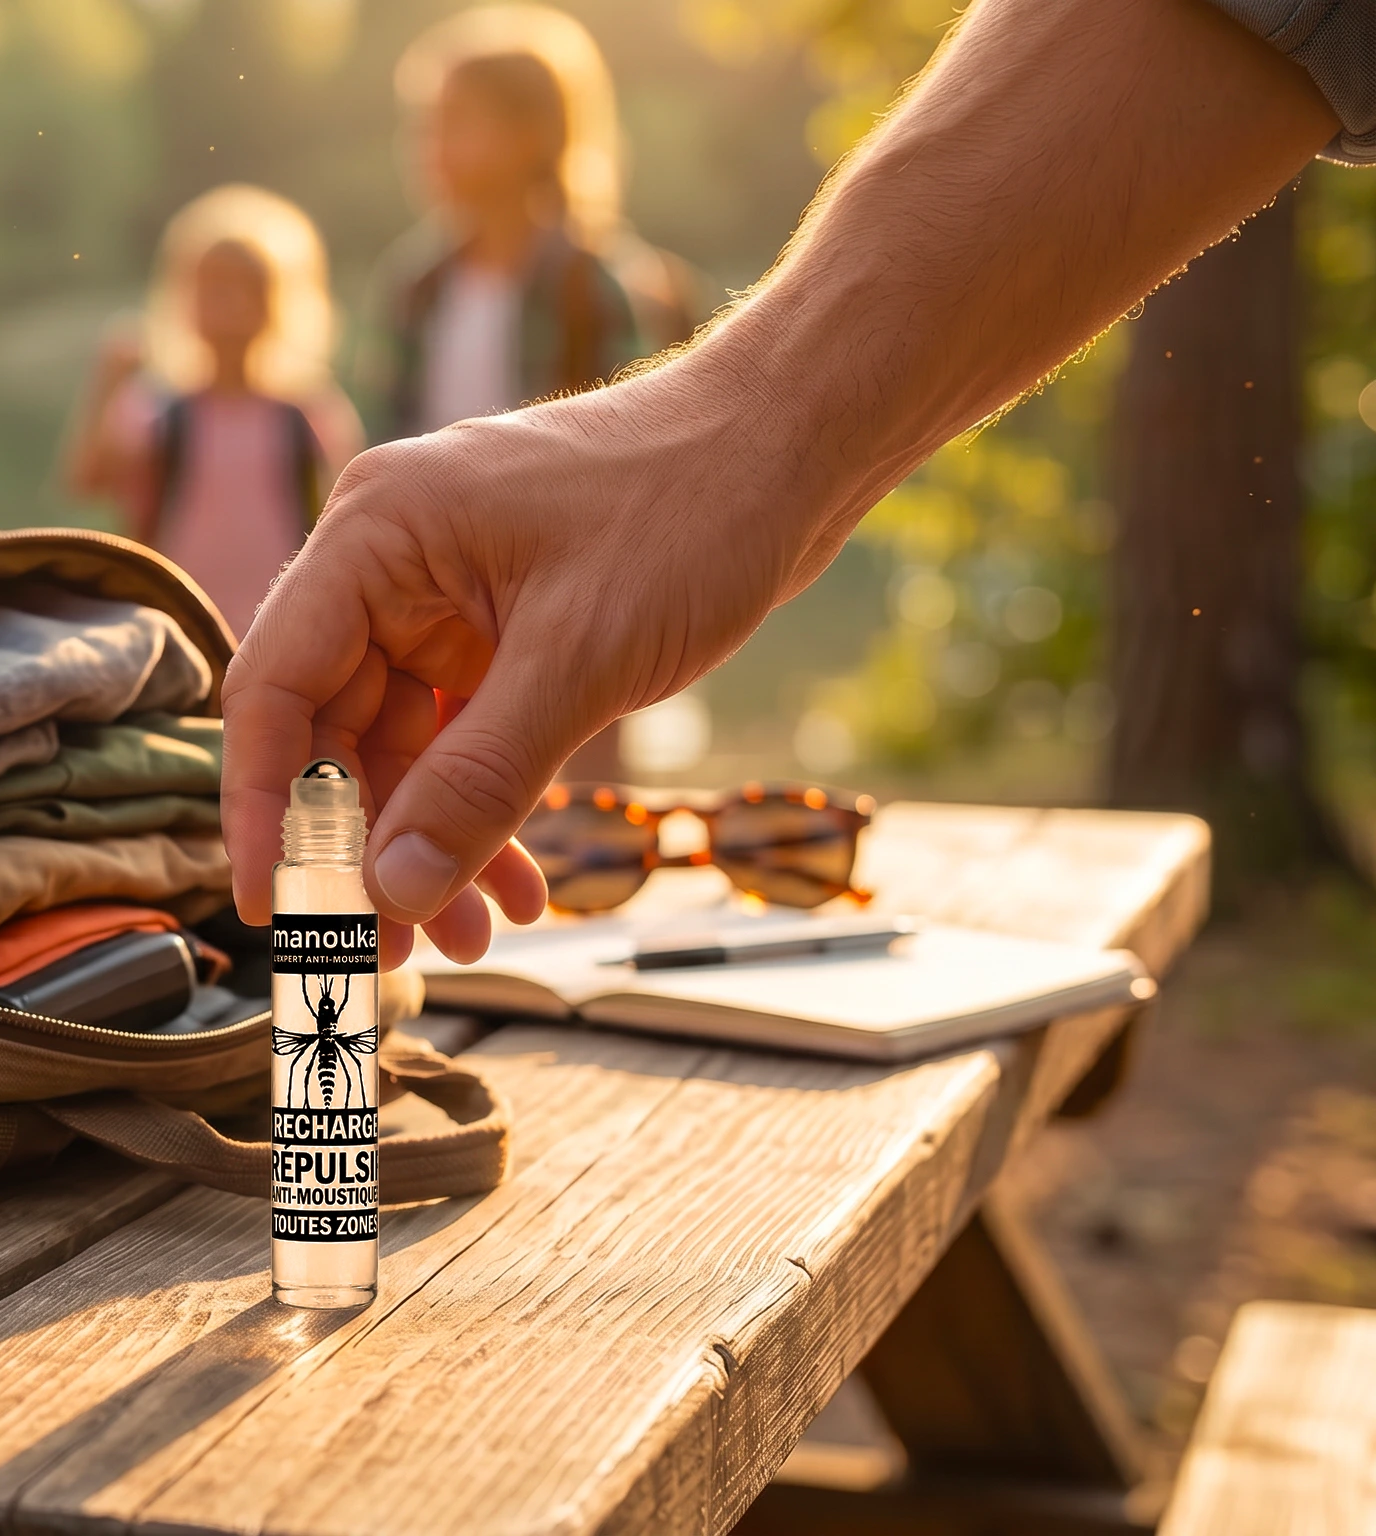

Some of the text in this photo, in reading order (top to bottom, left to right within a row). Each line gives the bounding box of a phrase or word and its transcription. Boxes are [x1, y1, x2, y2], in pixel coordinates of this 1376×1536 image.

[273, 923, 377, 949] manouka
[273, 954, 378, 964] L'EXPERT ANTI-MOUSTIQUES
[274, 1112, 378, 1139] RECHARGE
[273, 1213, 378, 1236] TOUTES ZONES
